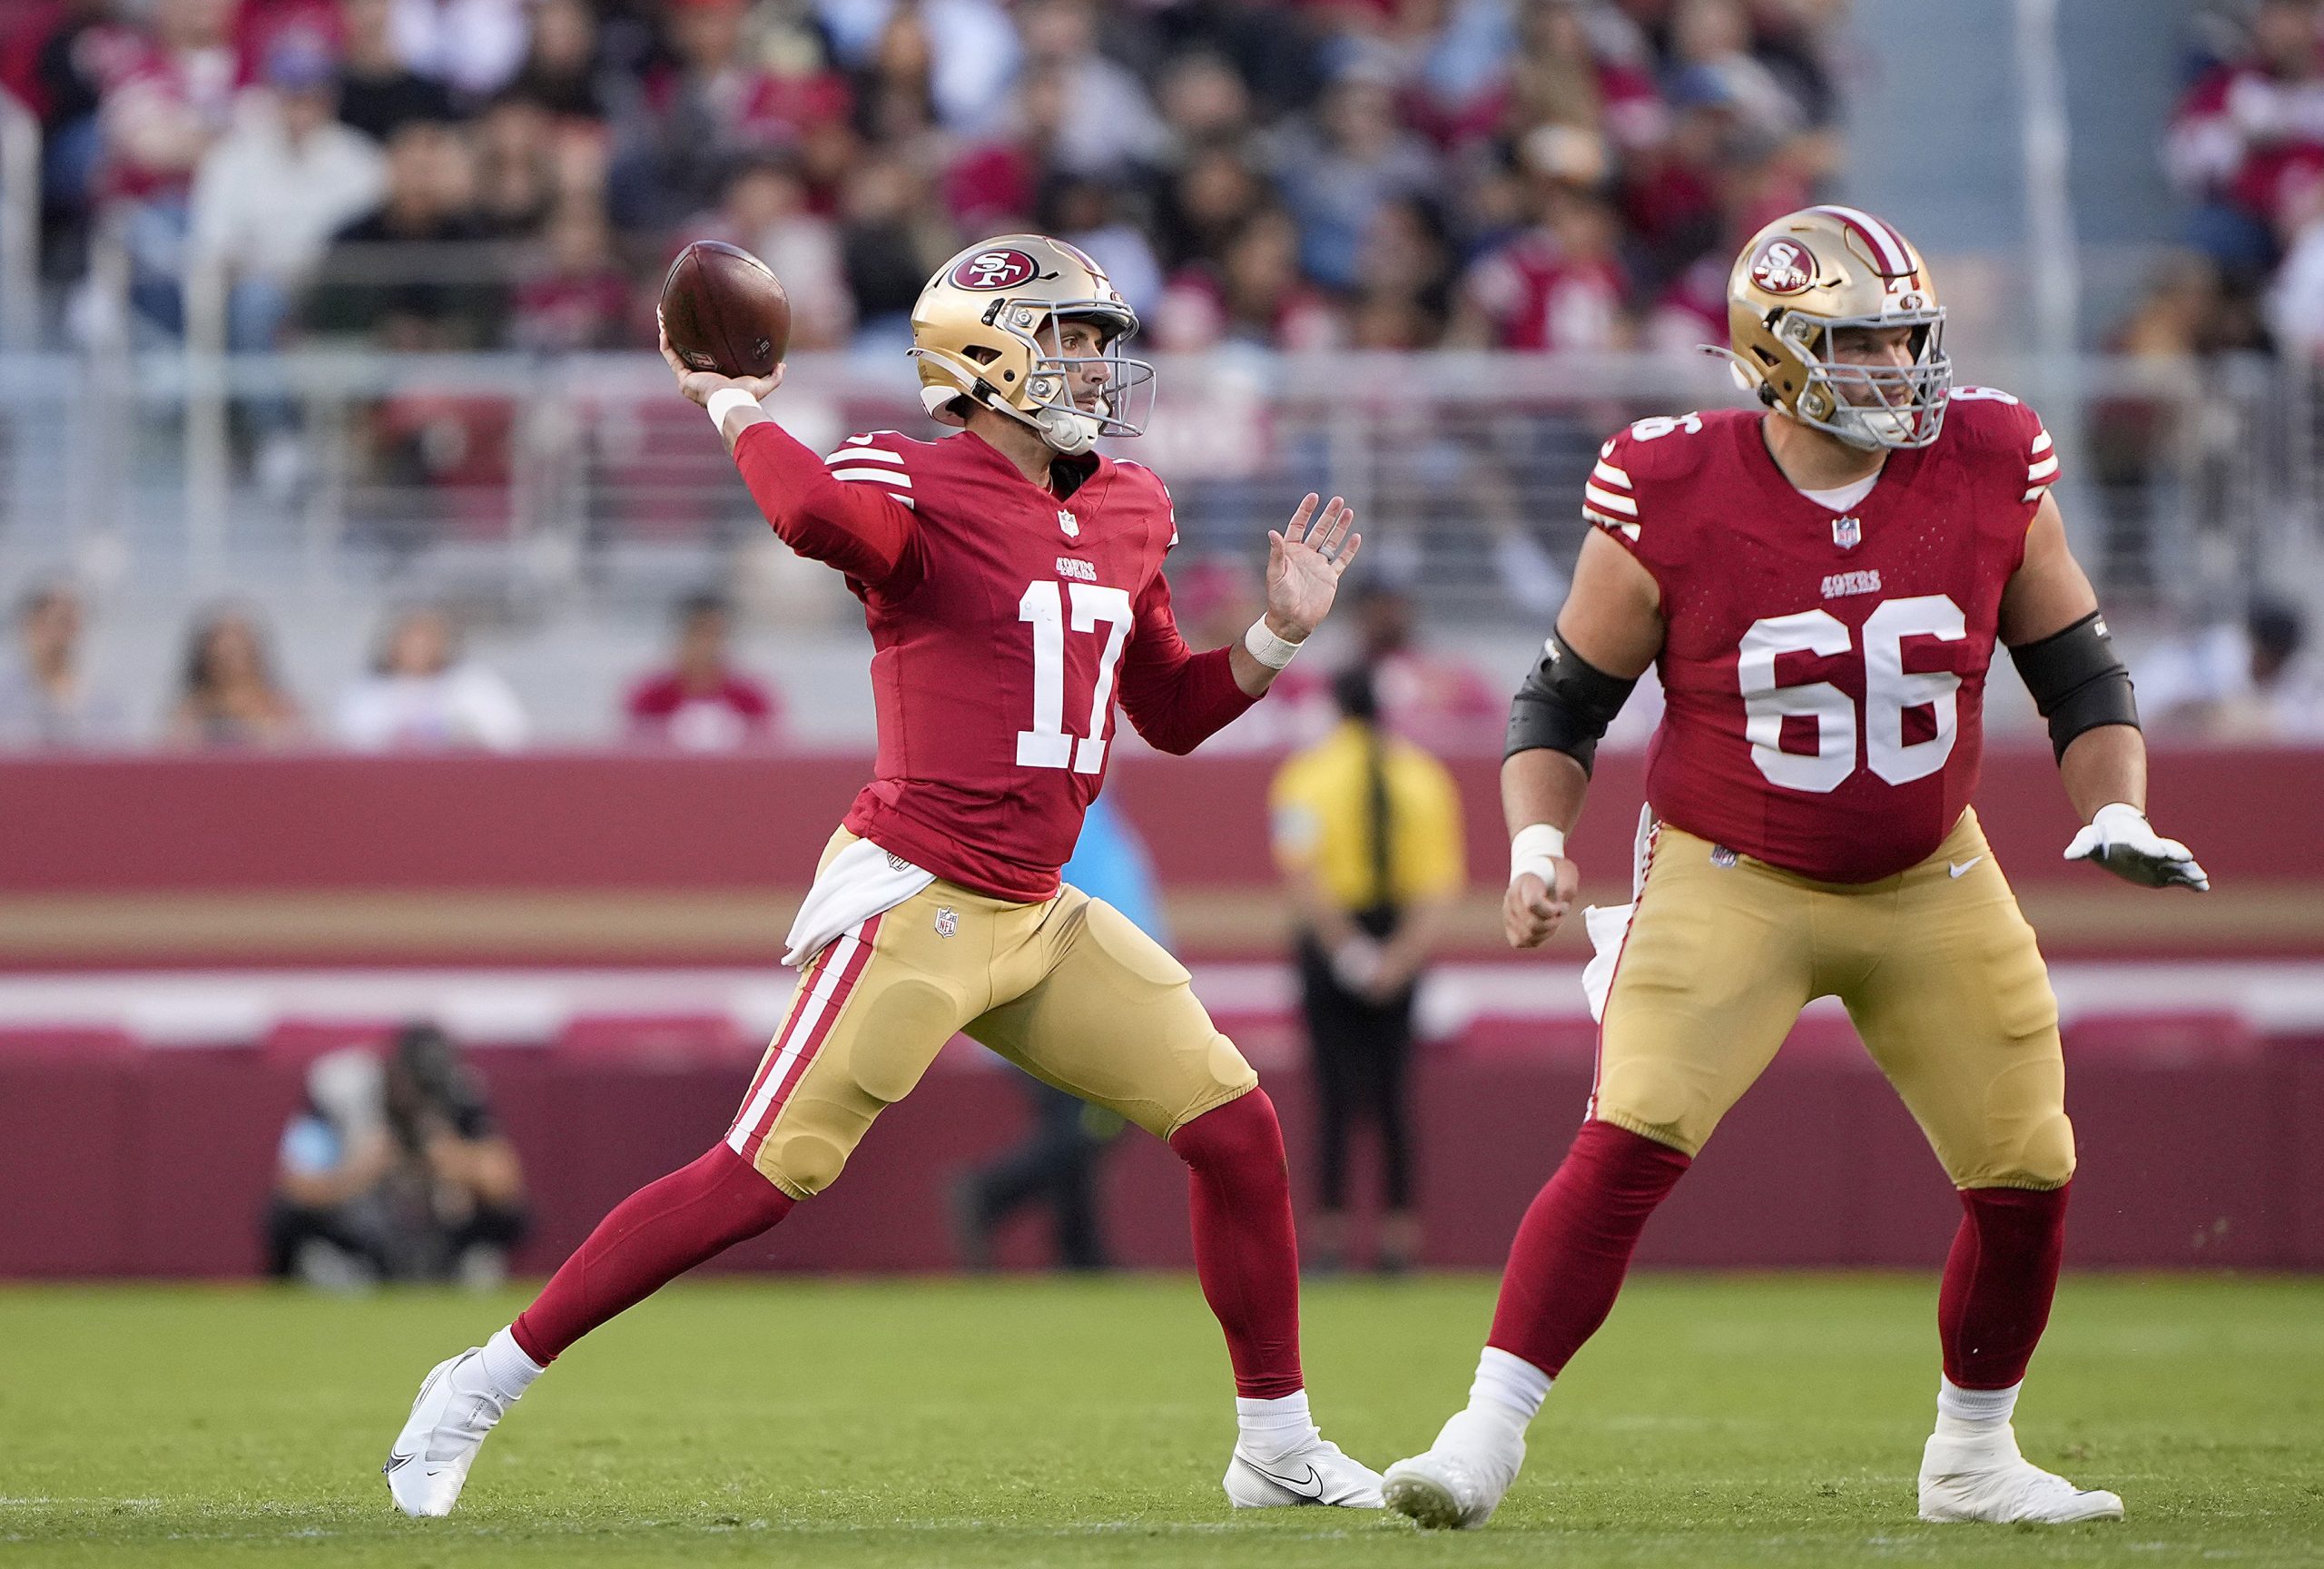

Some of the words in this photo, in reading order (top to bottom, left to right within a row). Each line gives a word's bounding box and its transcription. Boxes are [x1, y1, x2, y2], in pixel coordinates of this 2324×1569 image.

[969, 252, 1022, 286] SF
[1056, 557, 1098, 581] 49ERS
[1820, 568, 1882, 599] 49ERS
[1016, 580, 1134, 775] 17
[1738, 594, 1967, 794] 66
[939, 919, 954, 933] NFL
